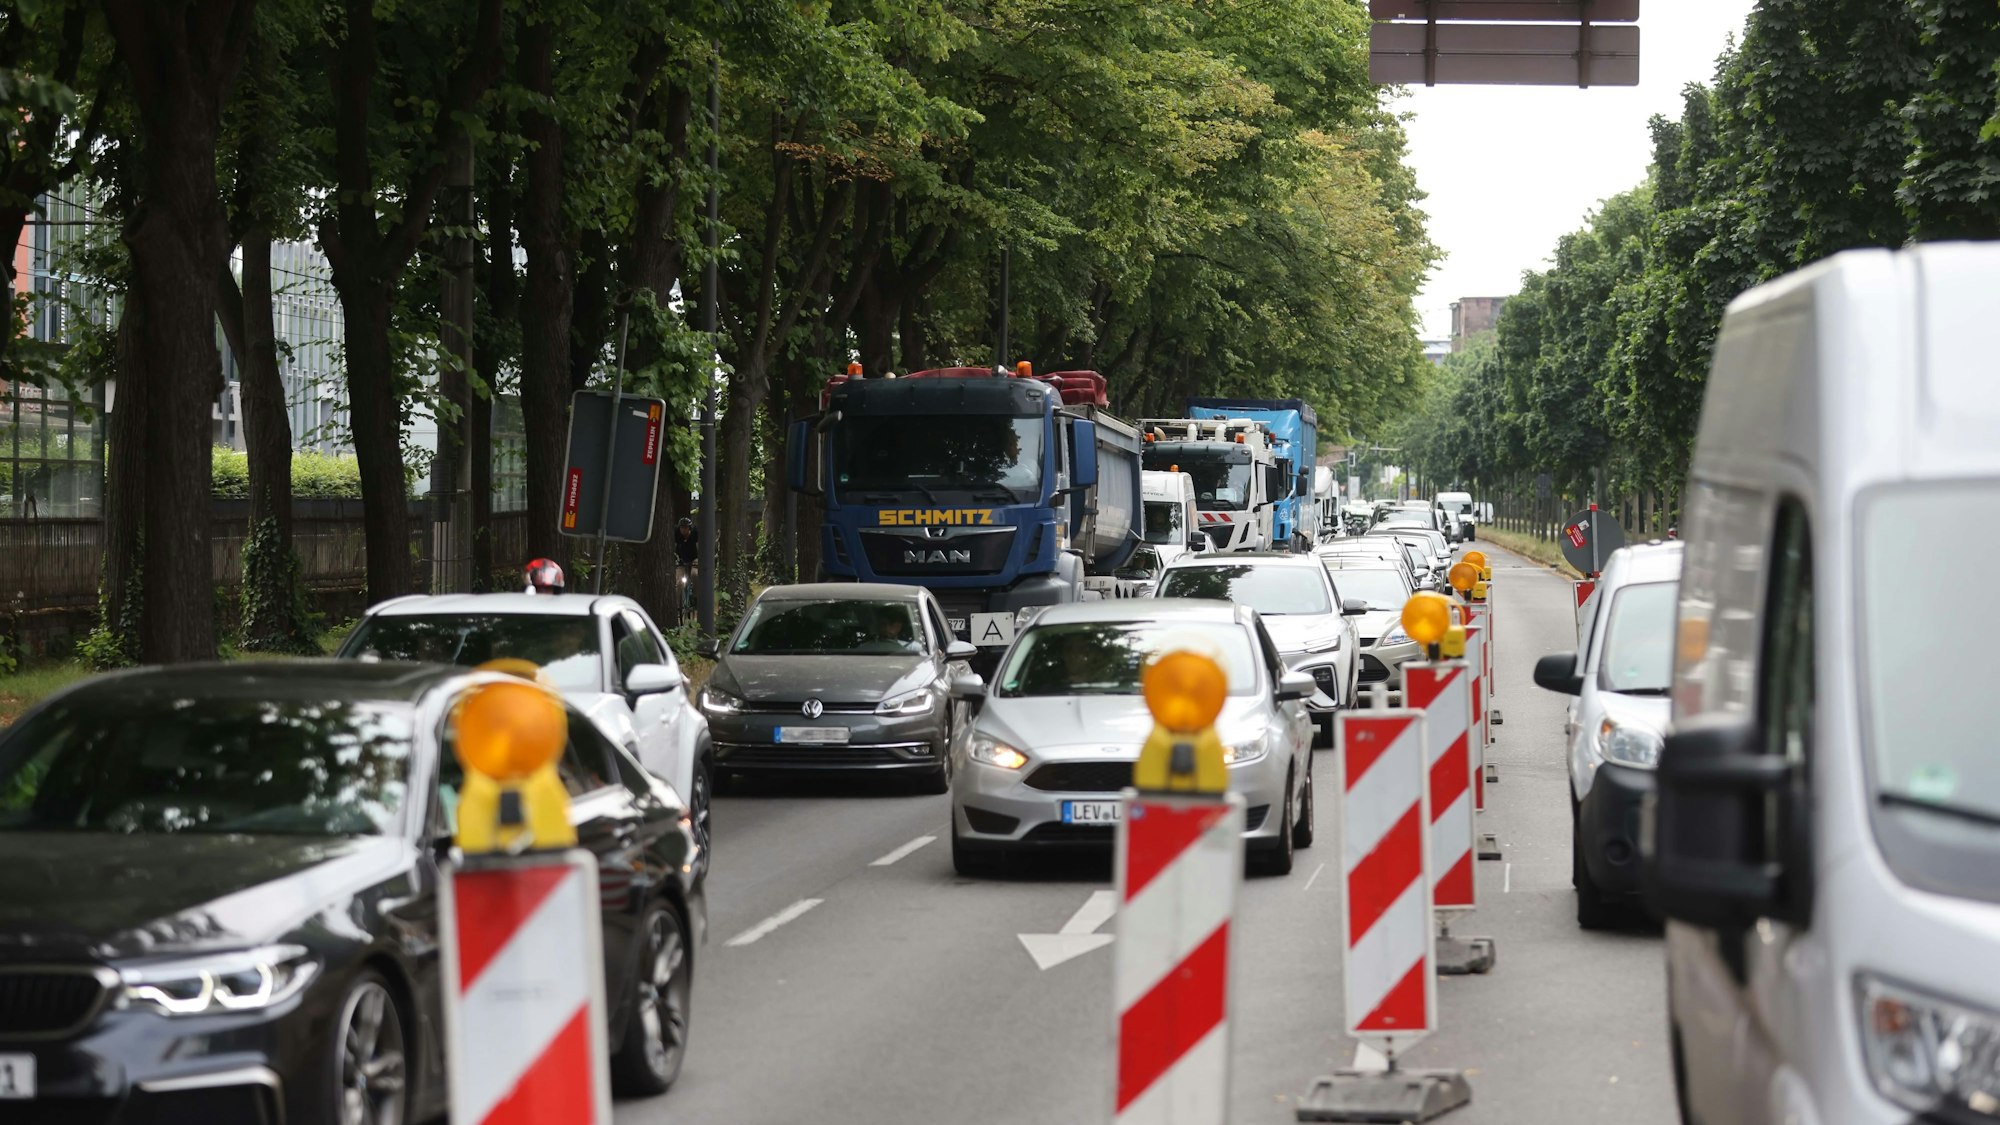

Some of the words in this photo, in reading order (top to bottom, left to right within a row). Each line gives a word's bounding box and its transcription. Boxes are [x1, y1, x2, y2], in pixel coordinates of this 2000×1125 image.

[647, 425, 656, 459] ZEPPELIN
[570, 474, 578, 507] ZEPPELIN
[879, 509, 993, 525] SCHMITZ
[904, 550, 971, 563] MAN
[982, 618, 1003, 640] A
[1073, 804, 1101, 820] LEV
